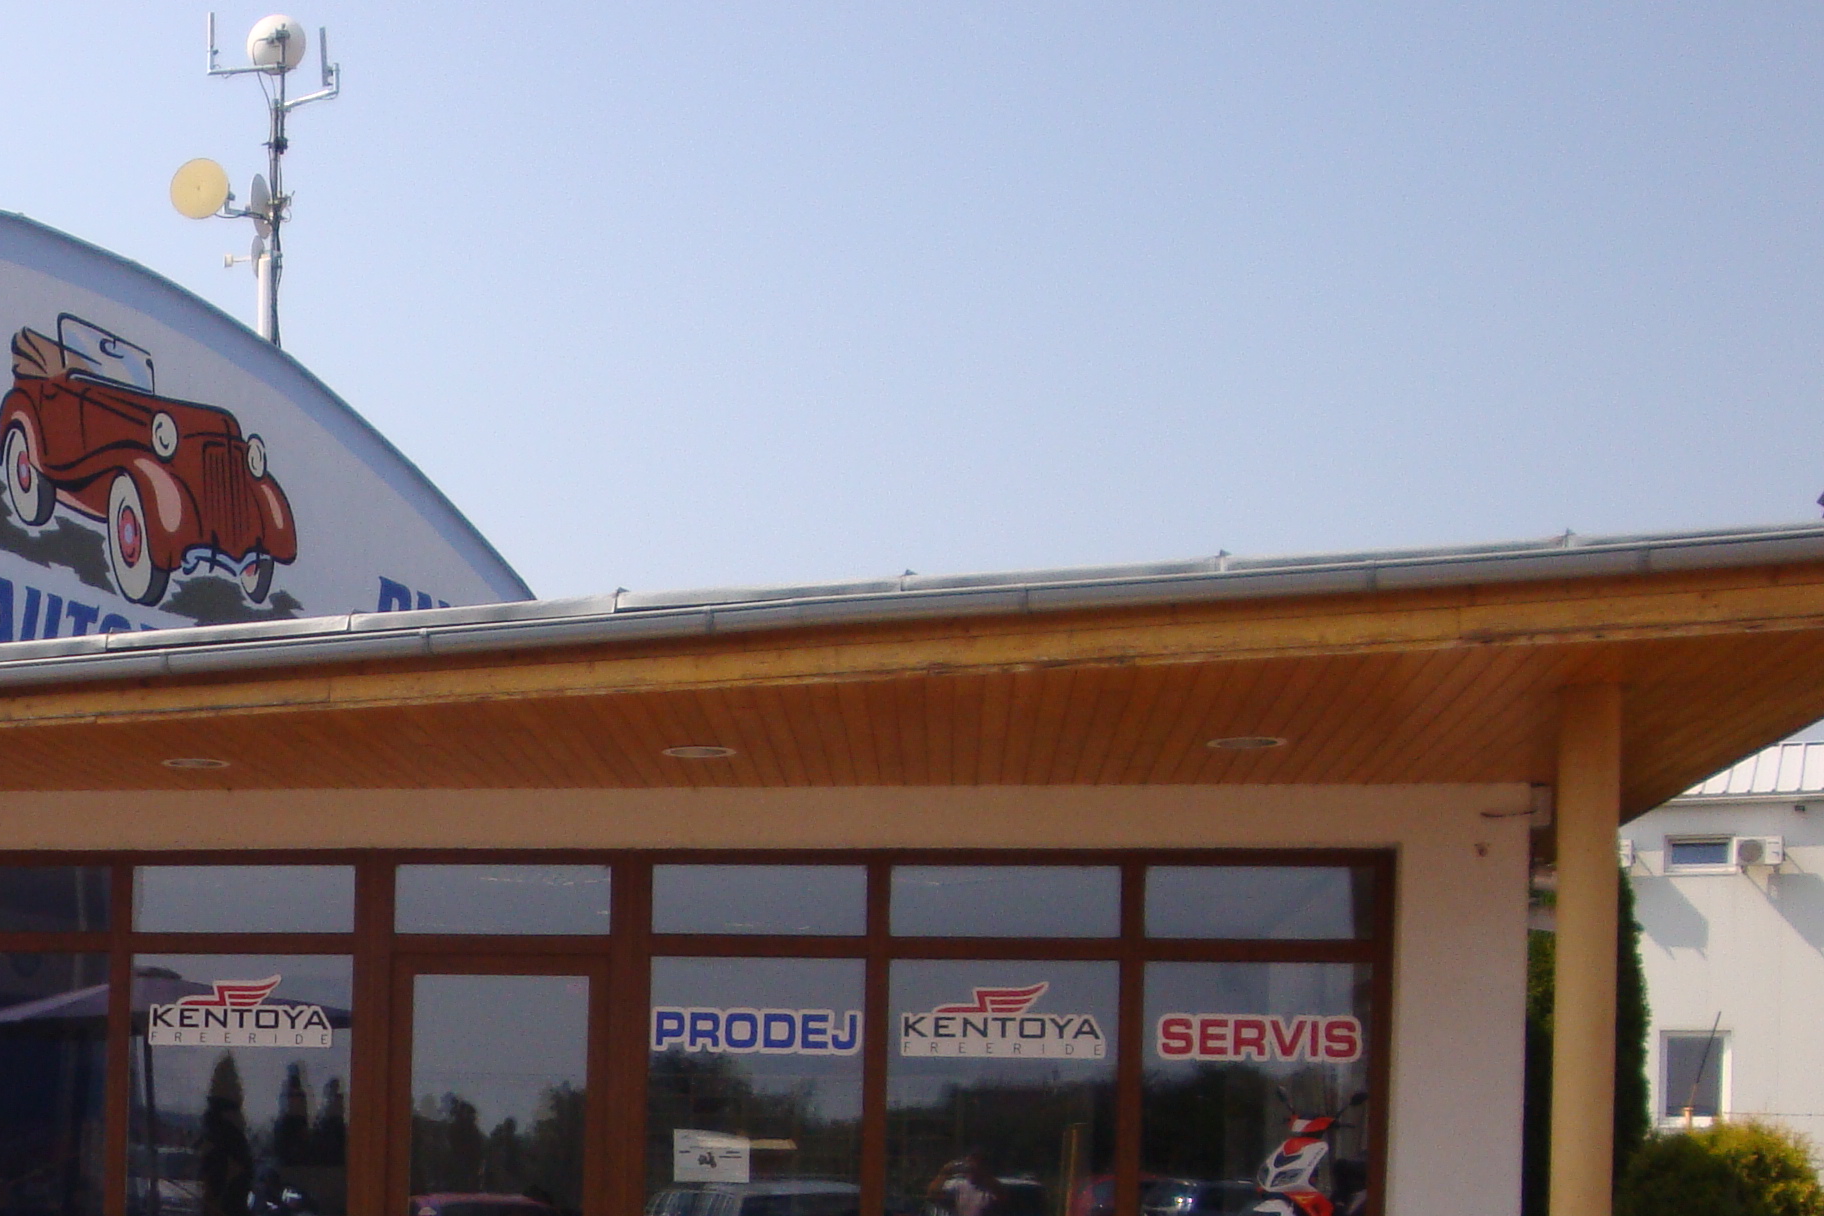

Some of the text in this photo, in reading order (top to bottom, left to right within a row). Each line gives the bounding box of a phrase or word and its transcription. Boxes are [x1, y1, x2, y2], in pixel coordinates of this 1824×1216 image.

[152, 1007, 328, 1030] KENTOYA
[903, 1016, 1101, 1040] KENTOYA
[150, 1031, 328, 1045] FREERIDE
[655, 1011, 858, 1050] PRODEJ
[1161, 1017, 1357, 1058] SERVIS
[902, 1041, 1104, 1056] FREERIDE
